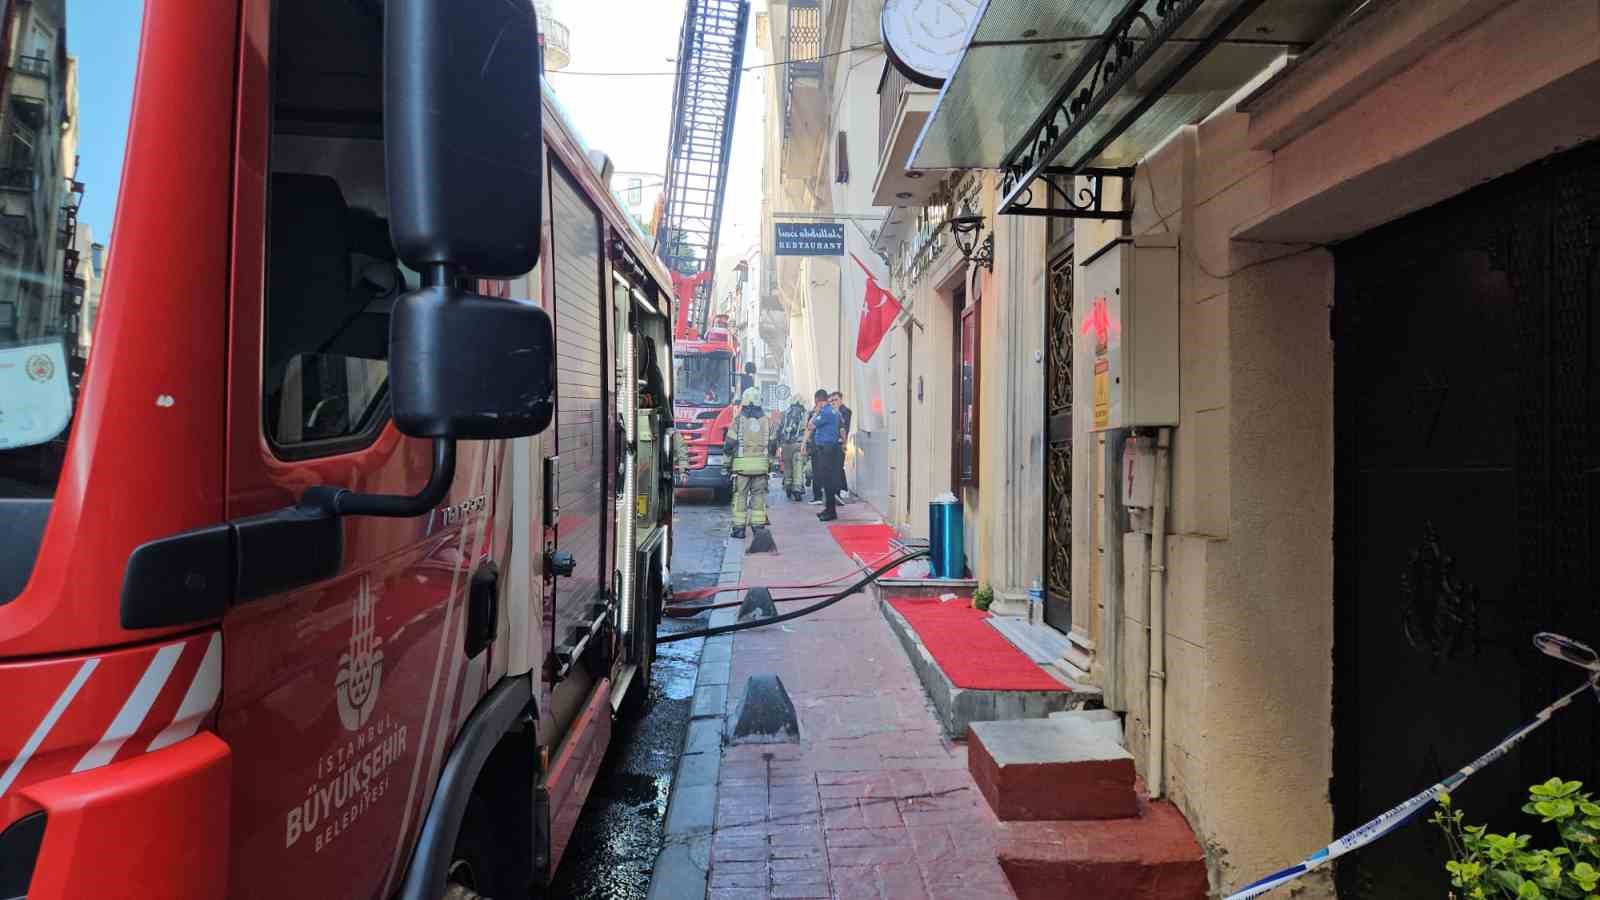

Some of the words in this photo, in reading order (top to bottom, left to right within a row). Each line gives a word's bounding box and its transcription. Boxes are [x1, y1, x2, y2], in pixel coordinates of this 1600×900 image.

[779, 241, 842, 249] RESTAURANT
[318, 713, 391, 778] İSTANBUL
[286, 724, 407, 848] BÜYÜKŞEHİR
[315, 775, 390, 852] BELEDİYESİ
